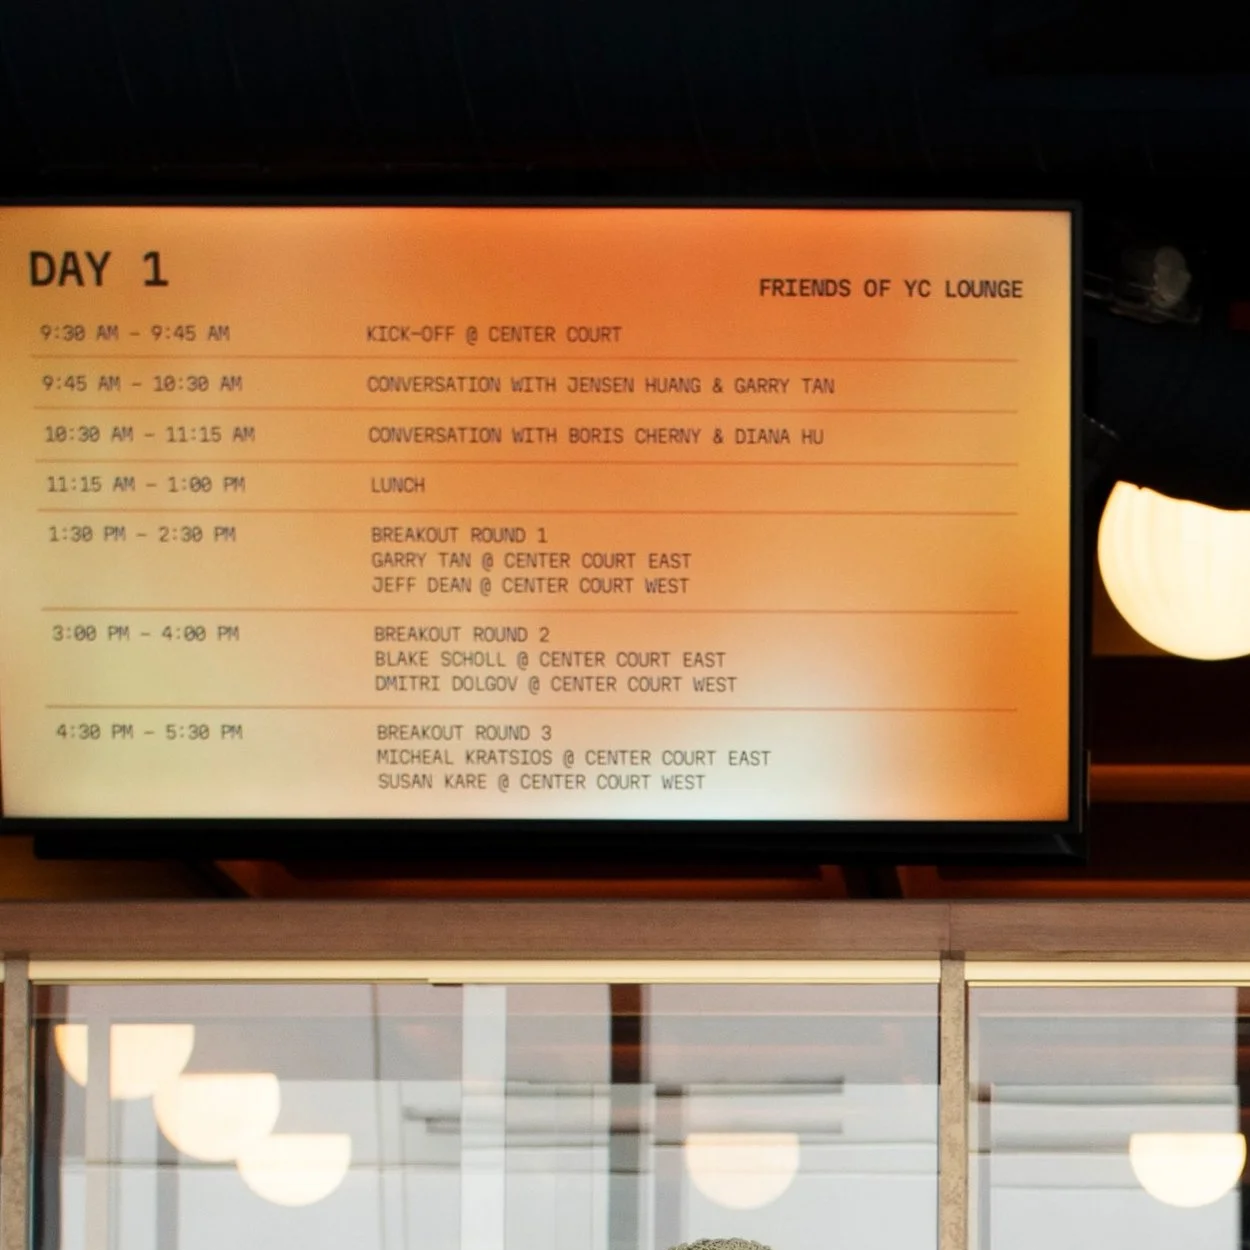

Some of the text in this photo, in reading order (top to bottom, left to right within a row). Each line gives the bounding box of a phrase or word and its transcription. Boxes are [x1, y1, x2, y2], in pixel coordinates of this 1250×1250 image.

[29, 250, 170, 288] DAY 1
[759, 278, 1024, 299] FRIENDS OF YC LOUNGE
[39, 323, 86, 342] 9:30
[95, 324, 120, 341] AM
[150, 323, 197, 342] 9:45
[206, 324, 231, 342] AM
[366, 324, 624, 347] KICK-OFF @ CENTER COURT
[41, 374, 88, 393] 9:45
[97, 374, 122, 392] AM
[153, 374, 210, 393] 10:30
[219, 374, 243, 392] AM
[366, 374, 835, 395] CONVERSATION WITH JENSEN HUANG & GARRY TAN
[45, 424, 101, 444] 10:30
[110, 425, 134, 443] AM
[166, 425, 222, 444] 11:15
[232, 425, 256, 443] AM
[367, 425, 825, 446] CONVERSATION WITH BORIS CHERNY & DIANA HU
[47, 475, 103, 493] 11:15
[112, 475, 136, 493] AM
[167, 475, 213, 494] 1:00
[222, 475, 246, 492] PM
[370, 476, 426, 494] LUNCH
[48, 524, 94, 544] 1:30
[103, 525, 127, 542] PM
[157, 525, 204, 544] 2:30
[212, 525, 237, 543] PM
[370, 525, 549, 544] BREAKOUT ROUND 1
[371, 551, 693, 573] GARRY TAN @ CENTER COURT EAST
[371, 575, 691, 597] JEFF DEAN @ CENTER COURT WEST
[52, 623, 98, 642] 3:00
[107, 624, 131, 641] PM
[161, 624, 207, 643] 4:00
[216, 625, 240, 641] PM
[373, 625, 551, 644] BREAKOUT ROUND 2
[374, 649, 727, 672] BLAKE SCHOLL @ CENTER COURT EAST
[374, 674, 738, 696] DMITRI DOLGOV @ CENTER COURT WEST
[55, 722, 102, 741] 4:30
[110, 723, 134, 740] PM
[165, 723, 211, 741] 5:30
[220, 723, 244, 741] PM
[376, 723, 552, 742] BREAKOUT ROUND 3
[376, 748, 772, 770] MICHEAL KRATSIOS @ CENTER COURT EAST
[377, 772, 706, 794] SUSAN KARE @ CENTER COURT WEST
